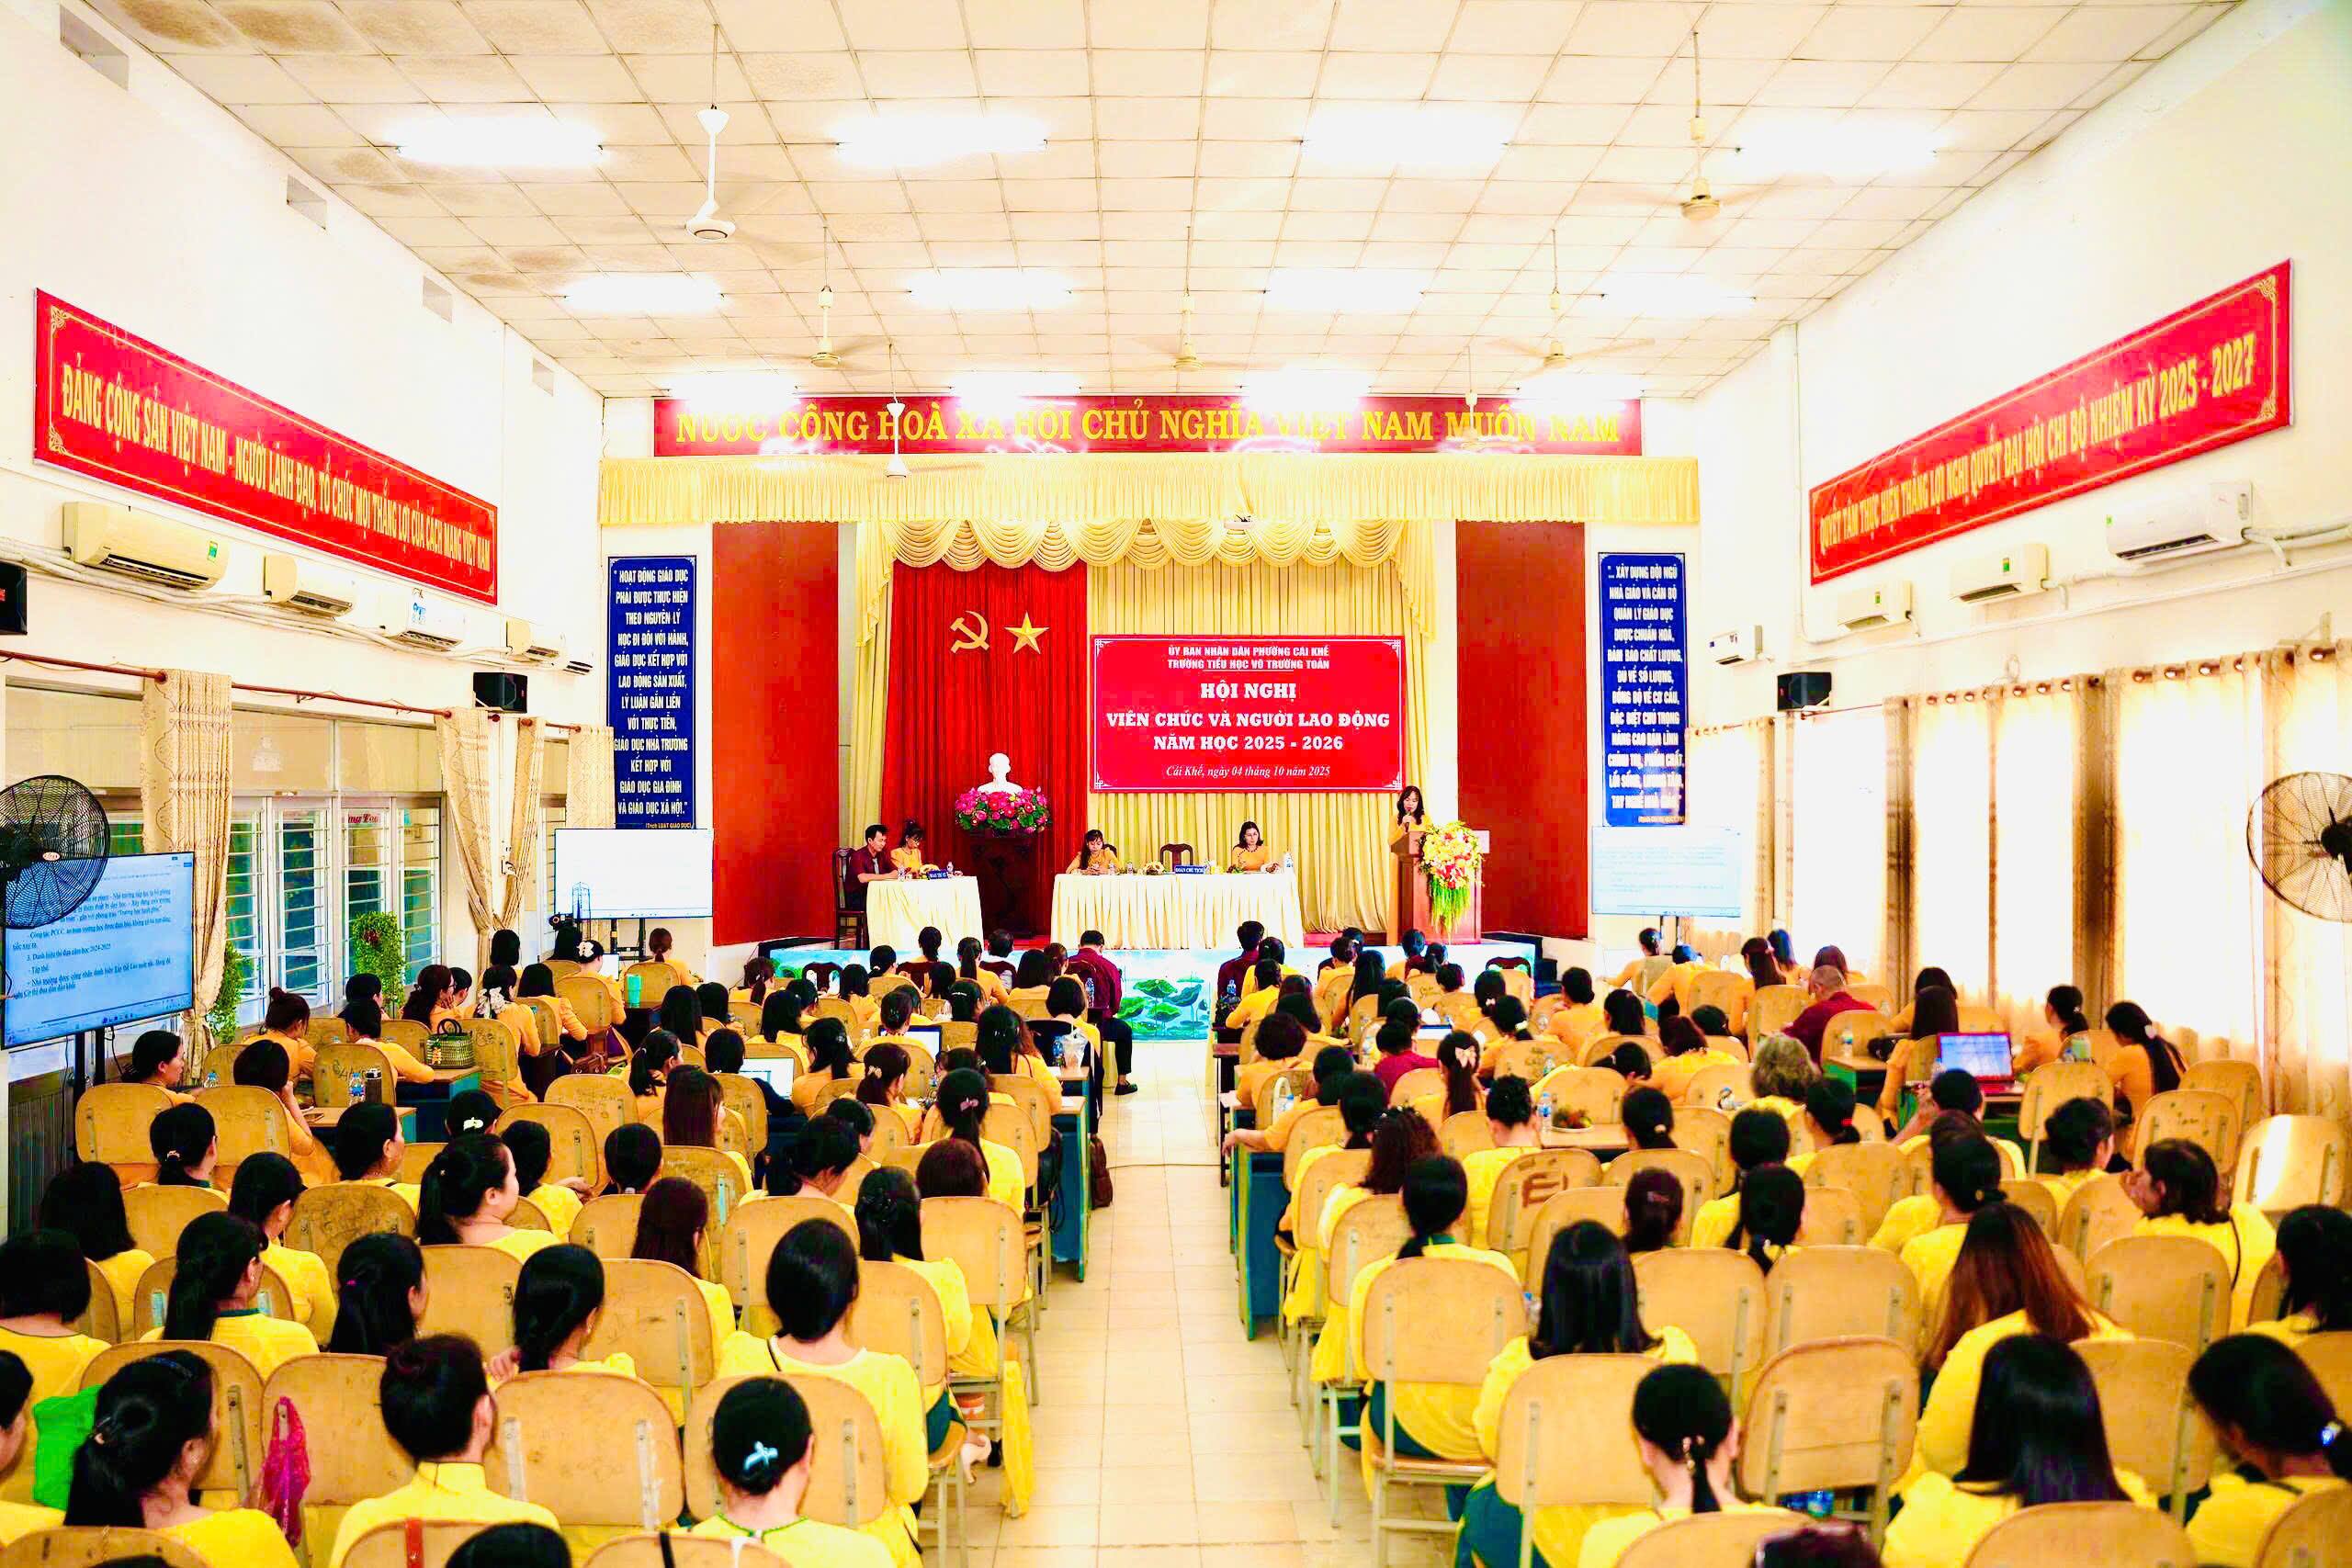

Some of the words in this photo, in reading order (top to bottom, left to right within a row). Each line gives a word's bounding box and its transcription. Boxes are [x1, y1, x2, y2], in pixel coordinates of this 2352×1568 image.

[778, 402, 869, 441] CÔNG
[876, 400, 948, 441] HOÀ
[1013, 401, 1073, 448] HỘI
[1081, 398, 1150, 441] CHỦ
[1159, 402, 1265, 441] NGHĨA
[1362, 410, 1433, 442] NAM
[1444, 403, 1537, 442] MUÔN
[1820, 496, 1841, 555] QUYẾT
[1842, 498, 1860, 540] TÂM
[1860, 493, 1880, 540] THỰC
[1881, 479, 1901, 533] HIỆN
[1901, 454, 1929, 517] THẮNG
[1930, 465, 1945, 514] LỢI
[1946, 455, 1970, 504] NGHỊ
[1971, 423, 2002, 499] QUYẾT
[2004, 433, 2022, 487] ĐẠI
[2024, 413, 2045, 480] HỘI
[2047, 413, 2066, 461] CHI
[2070, 393, 2087, 462] BỘ
[2090, 379, 2133, 450] NHIỆM
[2137, 362, 2155, 426] KỲ
[2159, 356, 2198, 419] 2025
[2211, 331, 2256, 398] 2027
[62, 353, 102, 429] ĐẢNG
[106, 371, 140, 453] CỘNG
[143, 385, 168, 453] SẢN
[171, 400, 199, 477] VIỆT
[200, 422, 227, 475] NAM
[235, 426, 267, 491] NGƯỜI
[268, 442, 295, 501] LÃNH
[296, 461, 317, 519] ĐẠO,
[319, 451, 331, 514] TỔ
[332, 470, 354, 523] CHỨC
[356, 486, 371, 540] MỌI
[372, 478, 397, 539] THẮNG
[398, 503, 411, 553] LỢI
[412, 499, 424, 548] CỦA
[426, 506, 443, 555] CÁCH
[444, 522, 462, 570] MẠNG
[462, 524, 477, 576] VIỆT
[478, 536, 491, 572] NAM
[638, 567, 656, 585] ĐỘNG
[657, 567, 673, 582] GIÁO
[674, 570, 688, 585] DỤC
[616, 587, 632, 604] PHẢI
[633, 591, 652, 606] ĐƯỢC
[653, 591, 671, 606] THỰC
[672, 587, 688, 606] HIỆN
[1624, 583, 1641, 599] GIÁO
[1642, 583, 1651, 599] VÀ
[625, 612, 642, 625] THEO
[643, 609, 671, 625] NGUYÊN
[673, 608, 681, 625] LÝ
[1643, 604, 1658, 620] GIÁO
[617, 633, 631, 649] HỌC
[632, 633, 639, 646] ĐI
[641, 629, 653, 646] ĐÔI
[654, 629, 666, 646] VỚI
[668, 629, 688, 647] HÀNH,
[614, 650, 630, 667] GIÁO
[632, 654, 646, 669] DỤC
[648, 649, 660, 666] KẾT
[661, 653, 675, 669] HỢP
[676, 649, 688, 666] VỚI
[1182, 647, 1202, 656] BAN
[1204, 646, 1229, 656] NHÂN
[1231, 646, 1250, 656] DÂN
[1253, 645, 1290, 656] PHƯỜNG
[1311, 645, 1329, 656] KHẾ
[1167, 659, 1204, 670] TRƯỜNG
[1207, 658, 1227, 669] TIỂU
[1229, 660, 1249, 671] HỌC
[1250, 659, 1264, 669] VÕ
[1266, 659, 1304, 670] TRƯỜNG
[618, 675, 631, 688] LAO
[633, 671, 652, 691] ĐỘNG
[653, 671, 667, 688] SẢN
[668, 670, 687, 689] XUẤT,
[622, 694, 629, 709] LÝ
[631, 694, 648, 711] LUẬN
[650, 691, 663, 709] GẮN
[665, 691, 681, 709] LIỀN
[1200, 680, 1238, 702] HỘI
[1244, 682, 1296, 703] NGHỊ
[628, 714, 639, 730] VỚI
[641, 716, 659, 732] THỰC
[661, 712, 677, 731] TIỄN,
[1106, 710, 1149, 727] VIÊN
[1155, 710, 1204, 727] CHỨC
[1208, 710, 1232, 727] VÀ
[1236, 709, 1294, 727] NGƯỜI
[1298, 713, 1333, 727] LAO
[1338, 709, 1390, 730] ĐỘNG
[614, 736, 629, 750] GIÁO
[631, 739, 644, 753] DỤC
[646, 735, 660, 750] NHÀ
[661, 735, 688, 750] TRƯỜNG
[1153, 732, 1194, 750] NĂM
[1201, 736, 1238, 752] HỌC
[1244, 736, 1284, 750] 2025
[1302, 736, 1344, 750] 2026
[631, 755, 642, 772] KẾT
[644, 760, 659, 774] HỢP
[660, 756, 672, 772] VỚI
[1166, 765, 1182, 776] Cái
[1184, 764, 1205, 777] Khế,
[1207, 767, 1229, 779] ngày
[1231, 766, 1242, 776] 04
[1245, 766, 1271, 778] tháng
[1273, 766, 1284, 776] 10
[1286, 766, 1306, 776] năm
[1308, 766, 1330, 776] 2025
[620, 777, 635, 794] GIÁO
[638, 781, 651, 795] DỤC
[652, 781, 664, 793] GIA
[665, 777, 682, 793] ĐÌNH
[617, 799, 627, 814] VÀ
[628, 799, 643, 815] GIÁO
[646, 802, 659, 817] DỤC
[660, 799, 670, 814] XÃ
